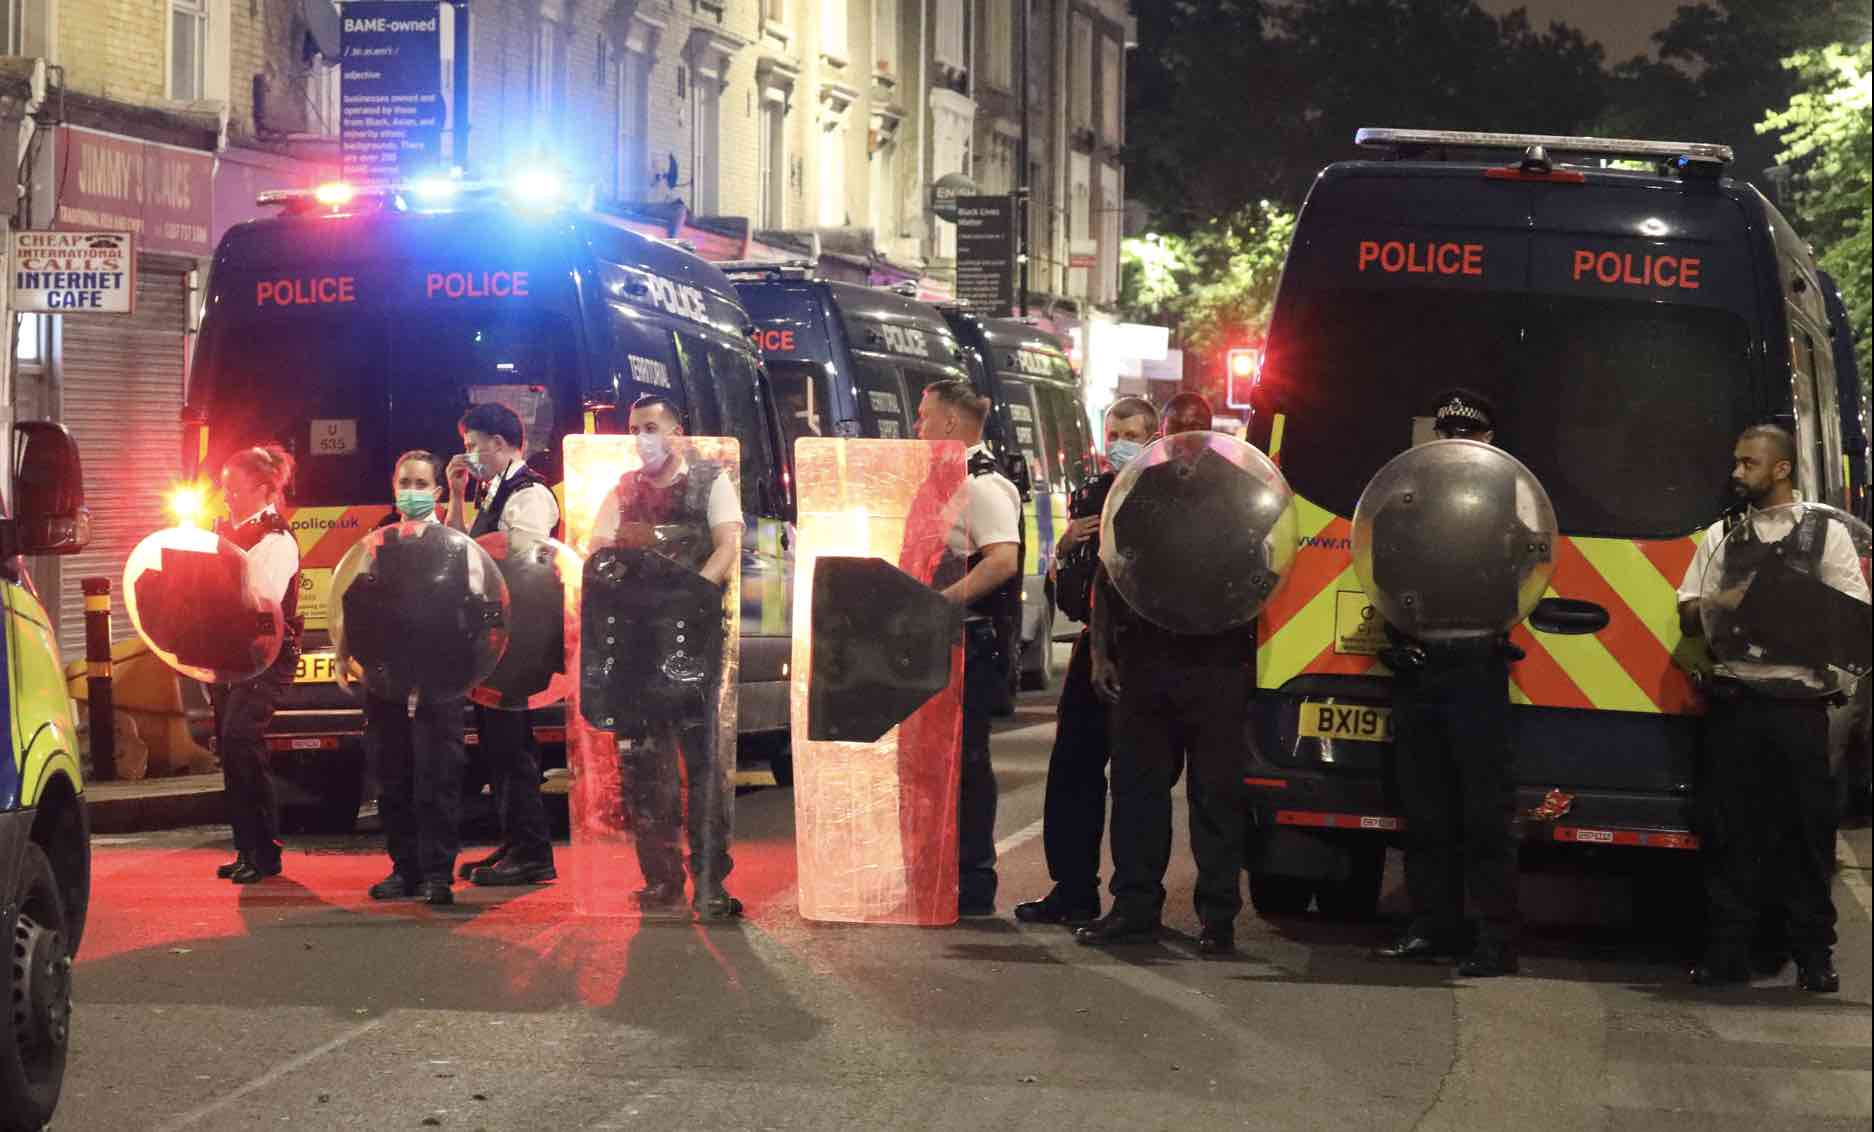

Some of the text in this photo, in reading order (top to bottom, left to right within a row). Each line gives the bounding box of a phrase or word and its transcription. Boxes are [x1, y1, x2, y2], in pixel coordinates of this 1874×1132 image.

[344, 17, 436, 32] BAME-owned
[958, 207, 1000, 217] Black Lives
[19, 233, 82, 247] CHEAP
[17, 247, 123, 258] INTERNATIONAL
[1358, 241, 1484, 275] POLICE
[22, 258, 120, 271] CALLS
[1572, 250, 1701, 289] POLICE
[16, 271, 124, 290] INTERNET
[426, 271, 529, 299] POLICE
[47, 290, 103, 309] CAFE
[256, 276, 356, 306] POLICE
[646, 273, 709, 323] POLICE
[757, 329, 796, 351] ICE
[881, 323, 929, 357] POLICE
[327, 423, 337, 436] U
[291, 516, 359, 531] police.uk
[1317, 706, 1378, 735] BX19
